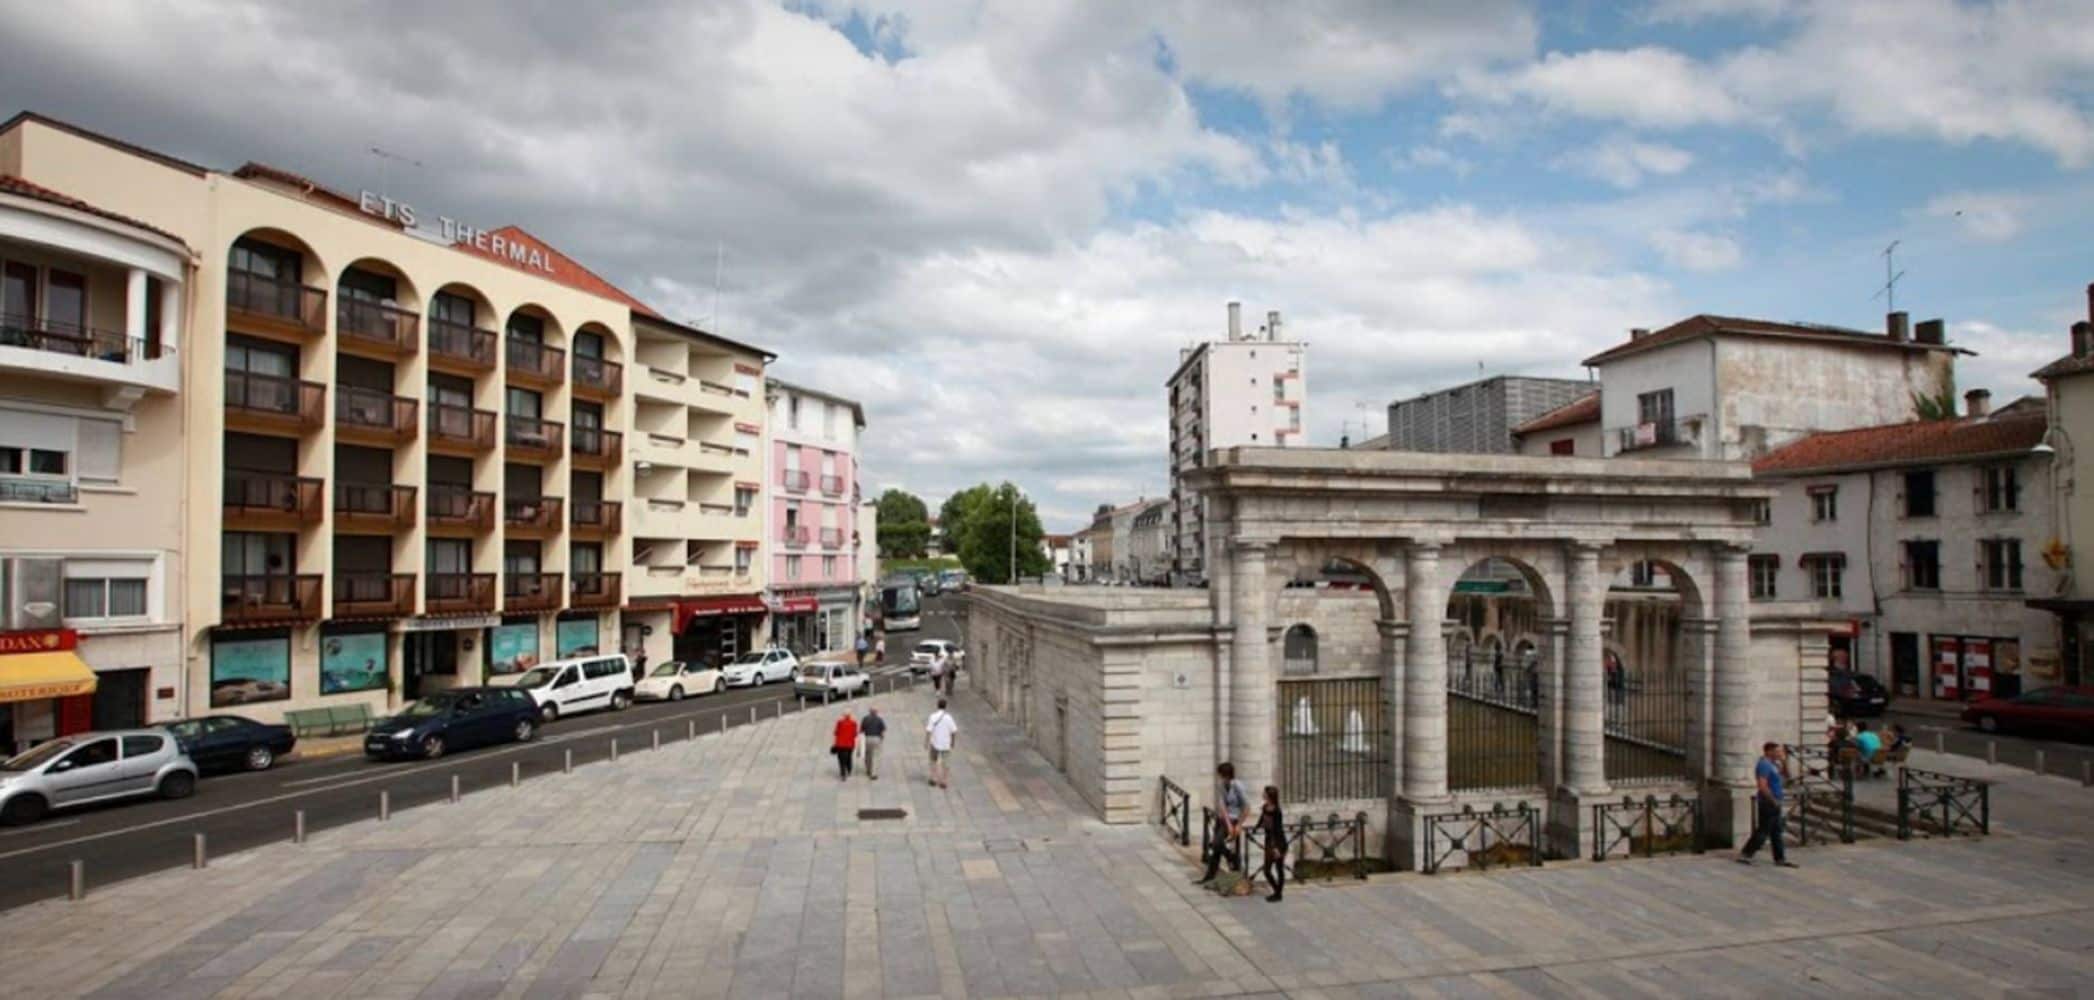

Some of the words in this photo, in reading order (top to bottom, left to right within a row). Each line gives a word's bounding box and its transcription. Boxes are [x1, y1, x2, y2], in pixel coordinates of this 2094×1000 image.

[360, 189, 416, 226] ETS
[439, 216, 554, 272] THERMAL
[0, 637, 42, 650] DAX
